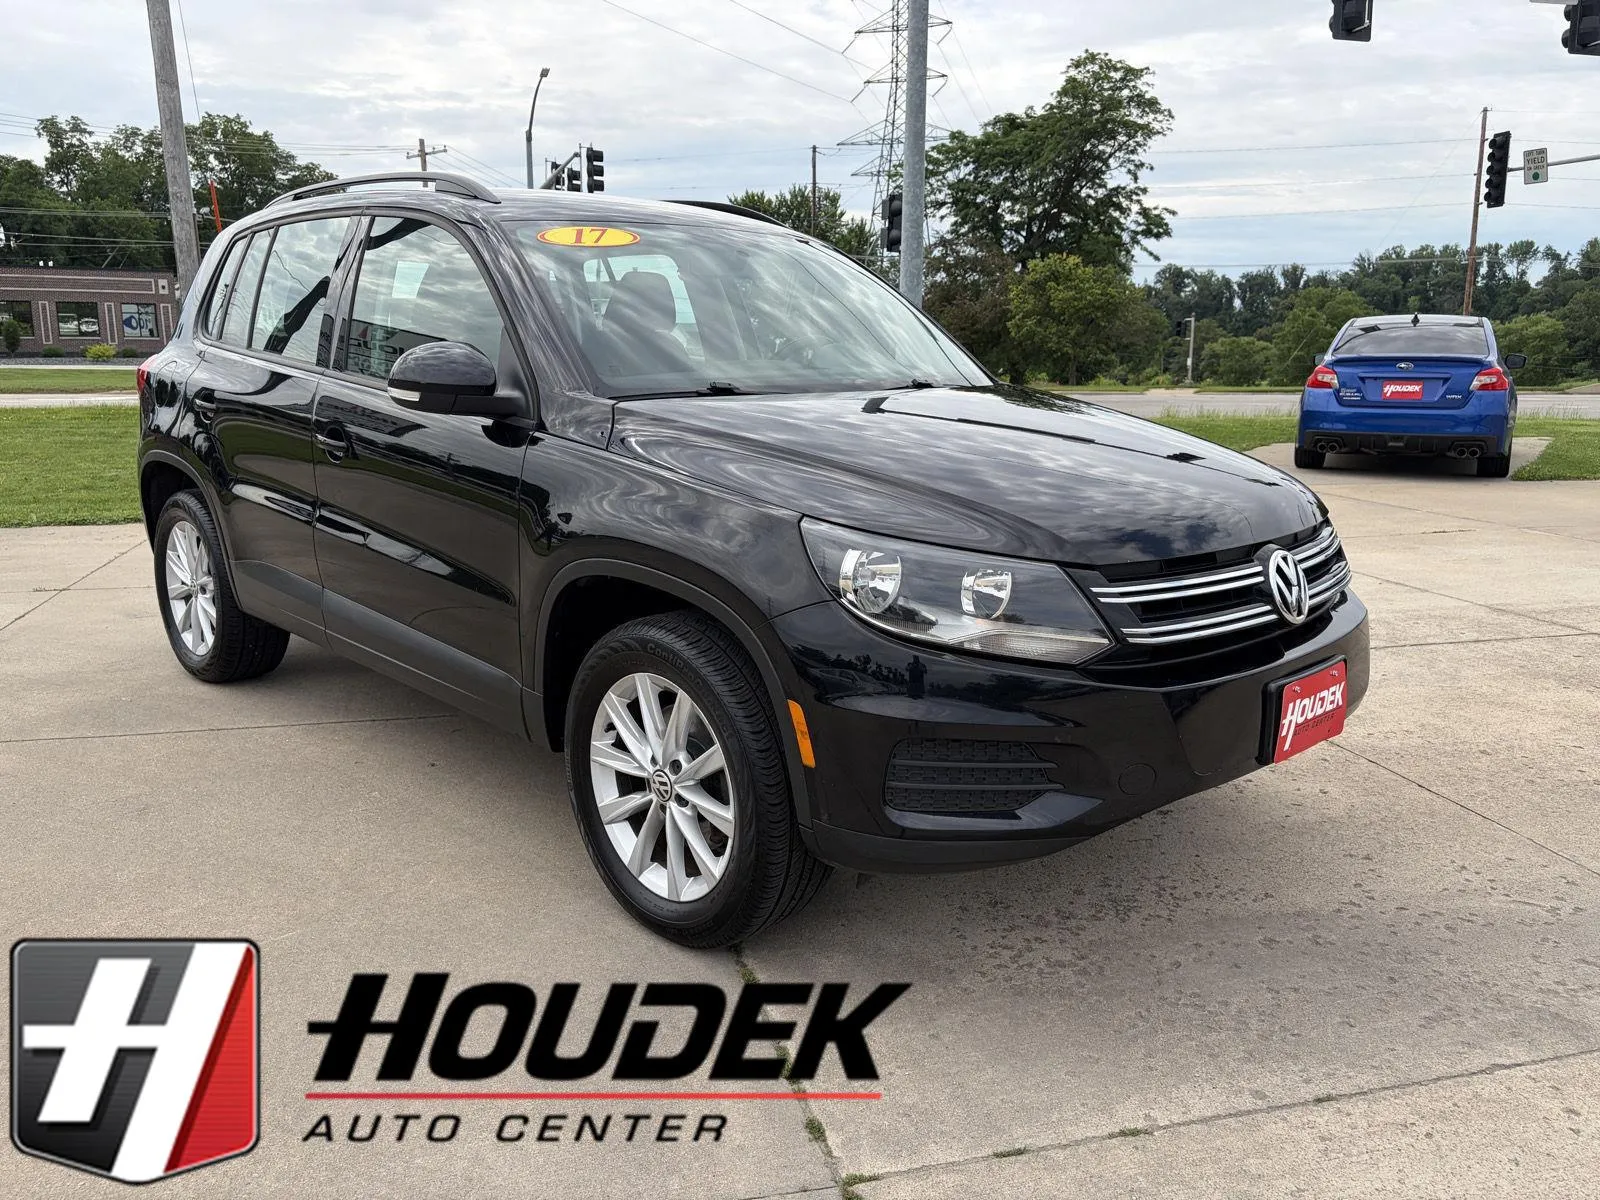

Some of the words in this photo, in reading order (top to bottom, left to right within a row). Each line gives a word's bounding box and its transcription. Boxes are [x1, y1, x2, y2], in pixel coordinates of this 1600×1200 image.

[1526, 156, 1545, 165] YIELD
[570, 228, 608, 244] 17
[1383, 384, 1423, 397] HOUDEK
[1281, 681, 1345, 751] HOUDEK
